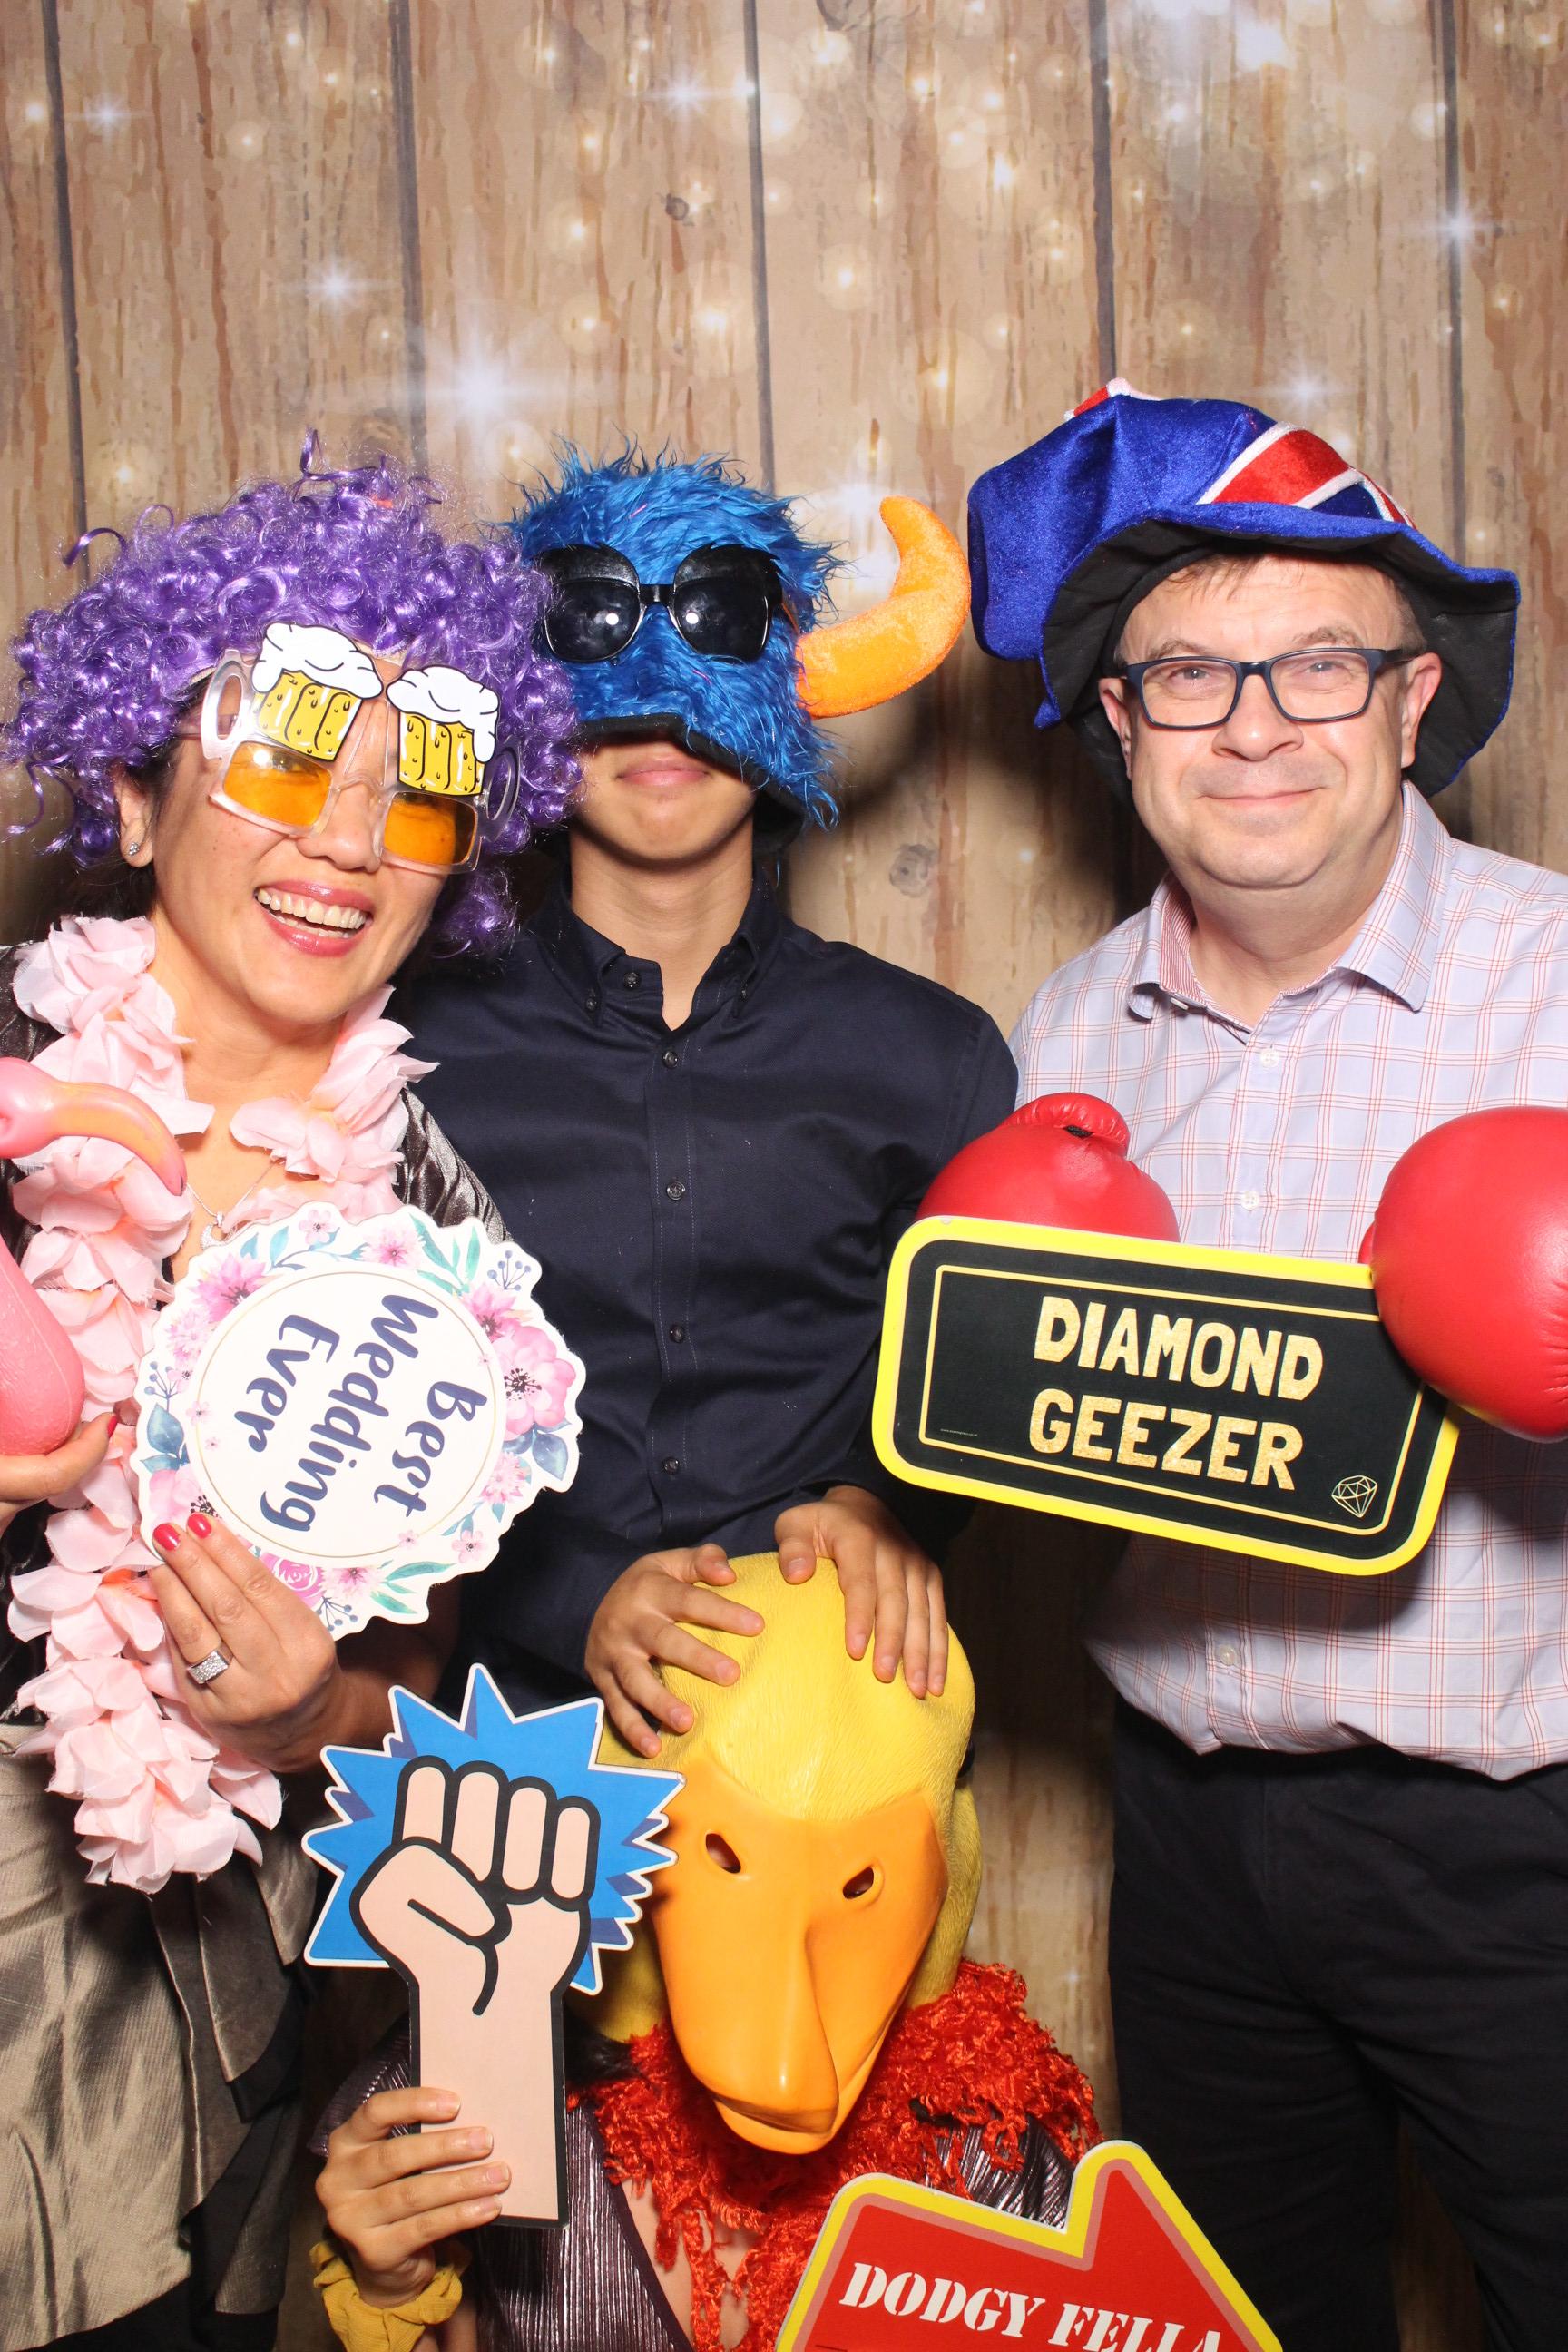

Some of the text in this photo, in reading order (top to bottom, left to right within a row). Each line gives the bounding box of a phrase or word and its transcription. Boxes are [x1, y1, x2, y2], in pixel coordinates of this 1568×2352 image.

[234, 1314, 340, 1453] Ever
[1034, 1295, 1324, 1401] DIAMOND
[260, 1294, 439, 1532] Wedding
[373, 1381, 487, 1518] Best
[1029, 1387, 1304, 1491] GEEZER
[838, 2262, 1046, 2338] DODGY
